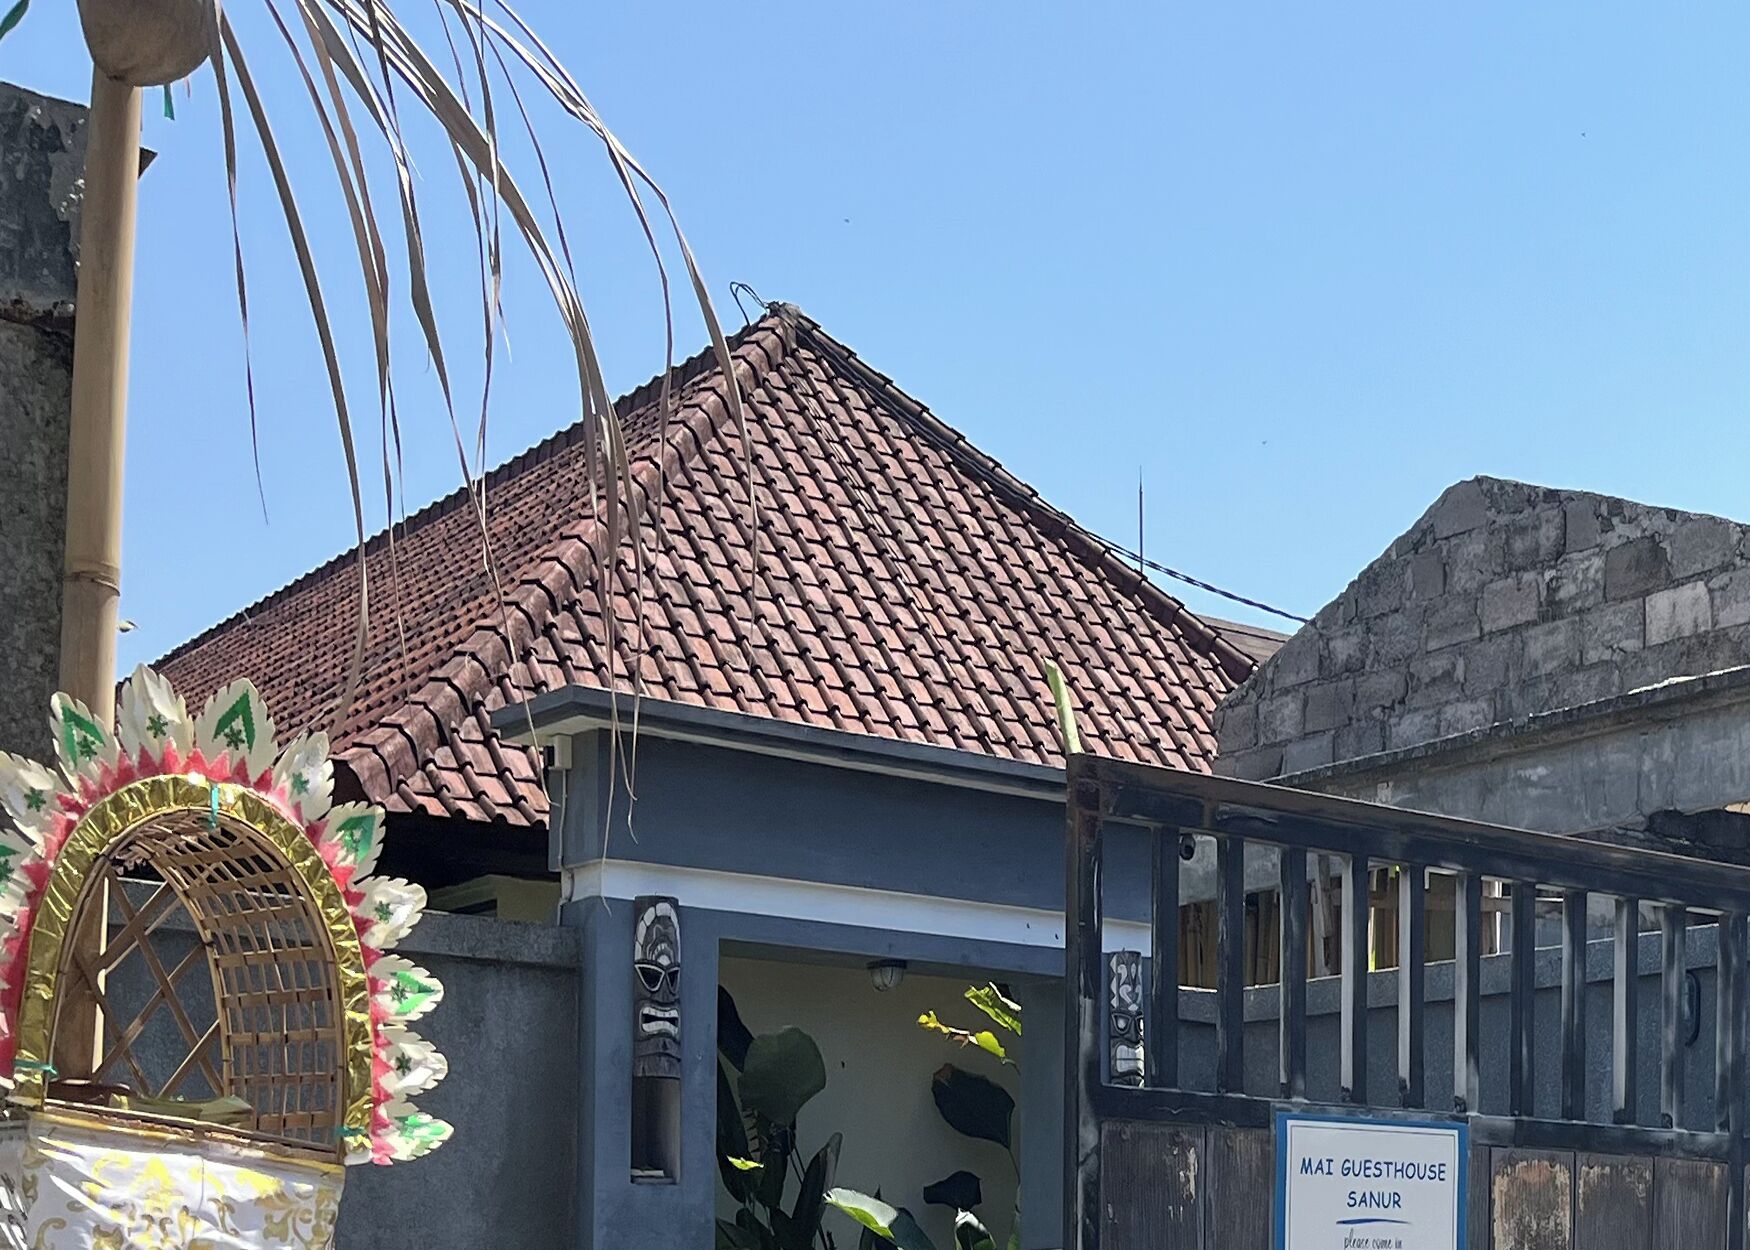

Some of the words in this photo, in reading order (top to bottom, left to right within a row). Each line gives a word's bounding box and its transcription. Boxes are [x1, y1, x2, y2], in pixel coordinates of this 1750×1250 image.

[1300, 1157, 1334, 1176] MAI
[1341, 1158, 1446, 1181] GUESTHOUSE
[1347, 1191, 1402, 1209] SANUR
[1371, 1238, 1393, 1250] come
